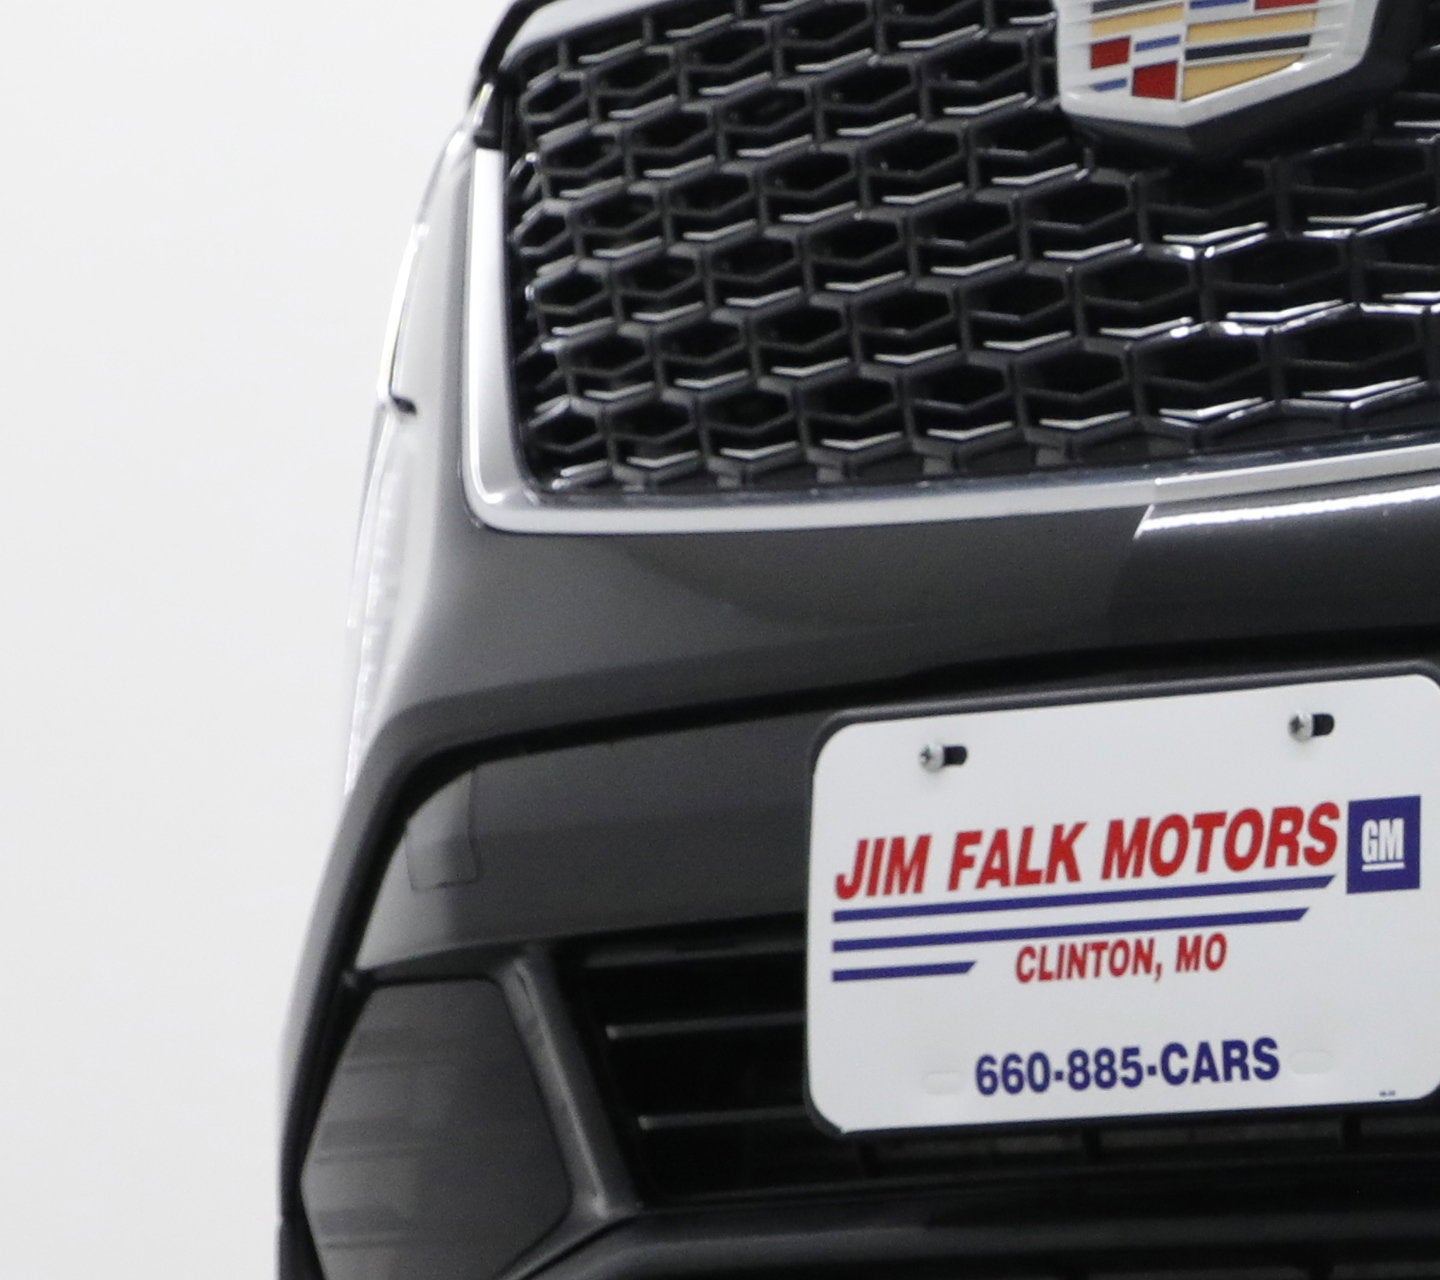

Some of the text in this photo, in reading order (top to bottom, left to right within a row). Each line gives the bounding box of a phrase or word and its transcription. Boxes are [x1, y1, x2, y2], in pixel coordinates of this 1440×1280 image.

[834, 801, 1341, 901] JIM FALK MOTORS
[1360, 817, 1406, 864] GM
[1015, 933, 1228, 983] CLINTON, MO
[974, 1036, 1281, 1096] 660-885-CARS
